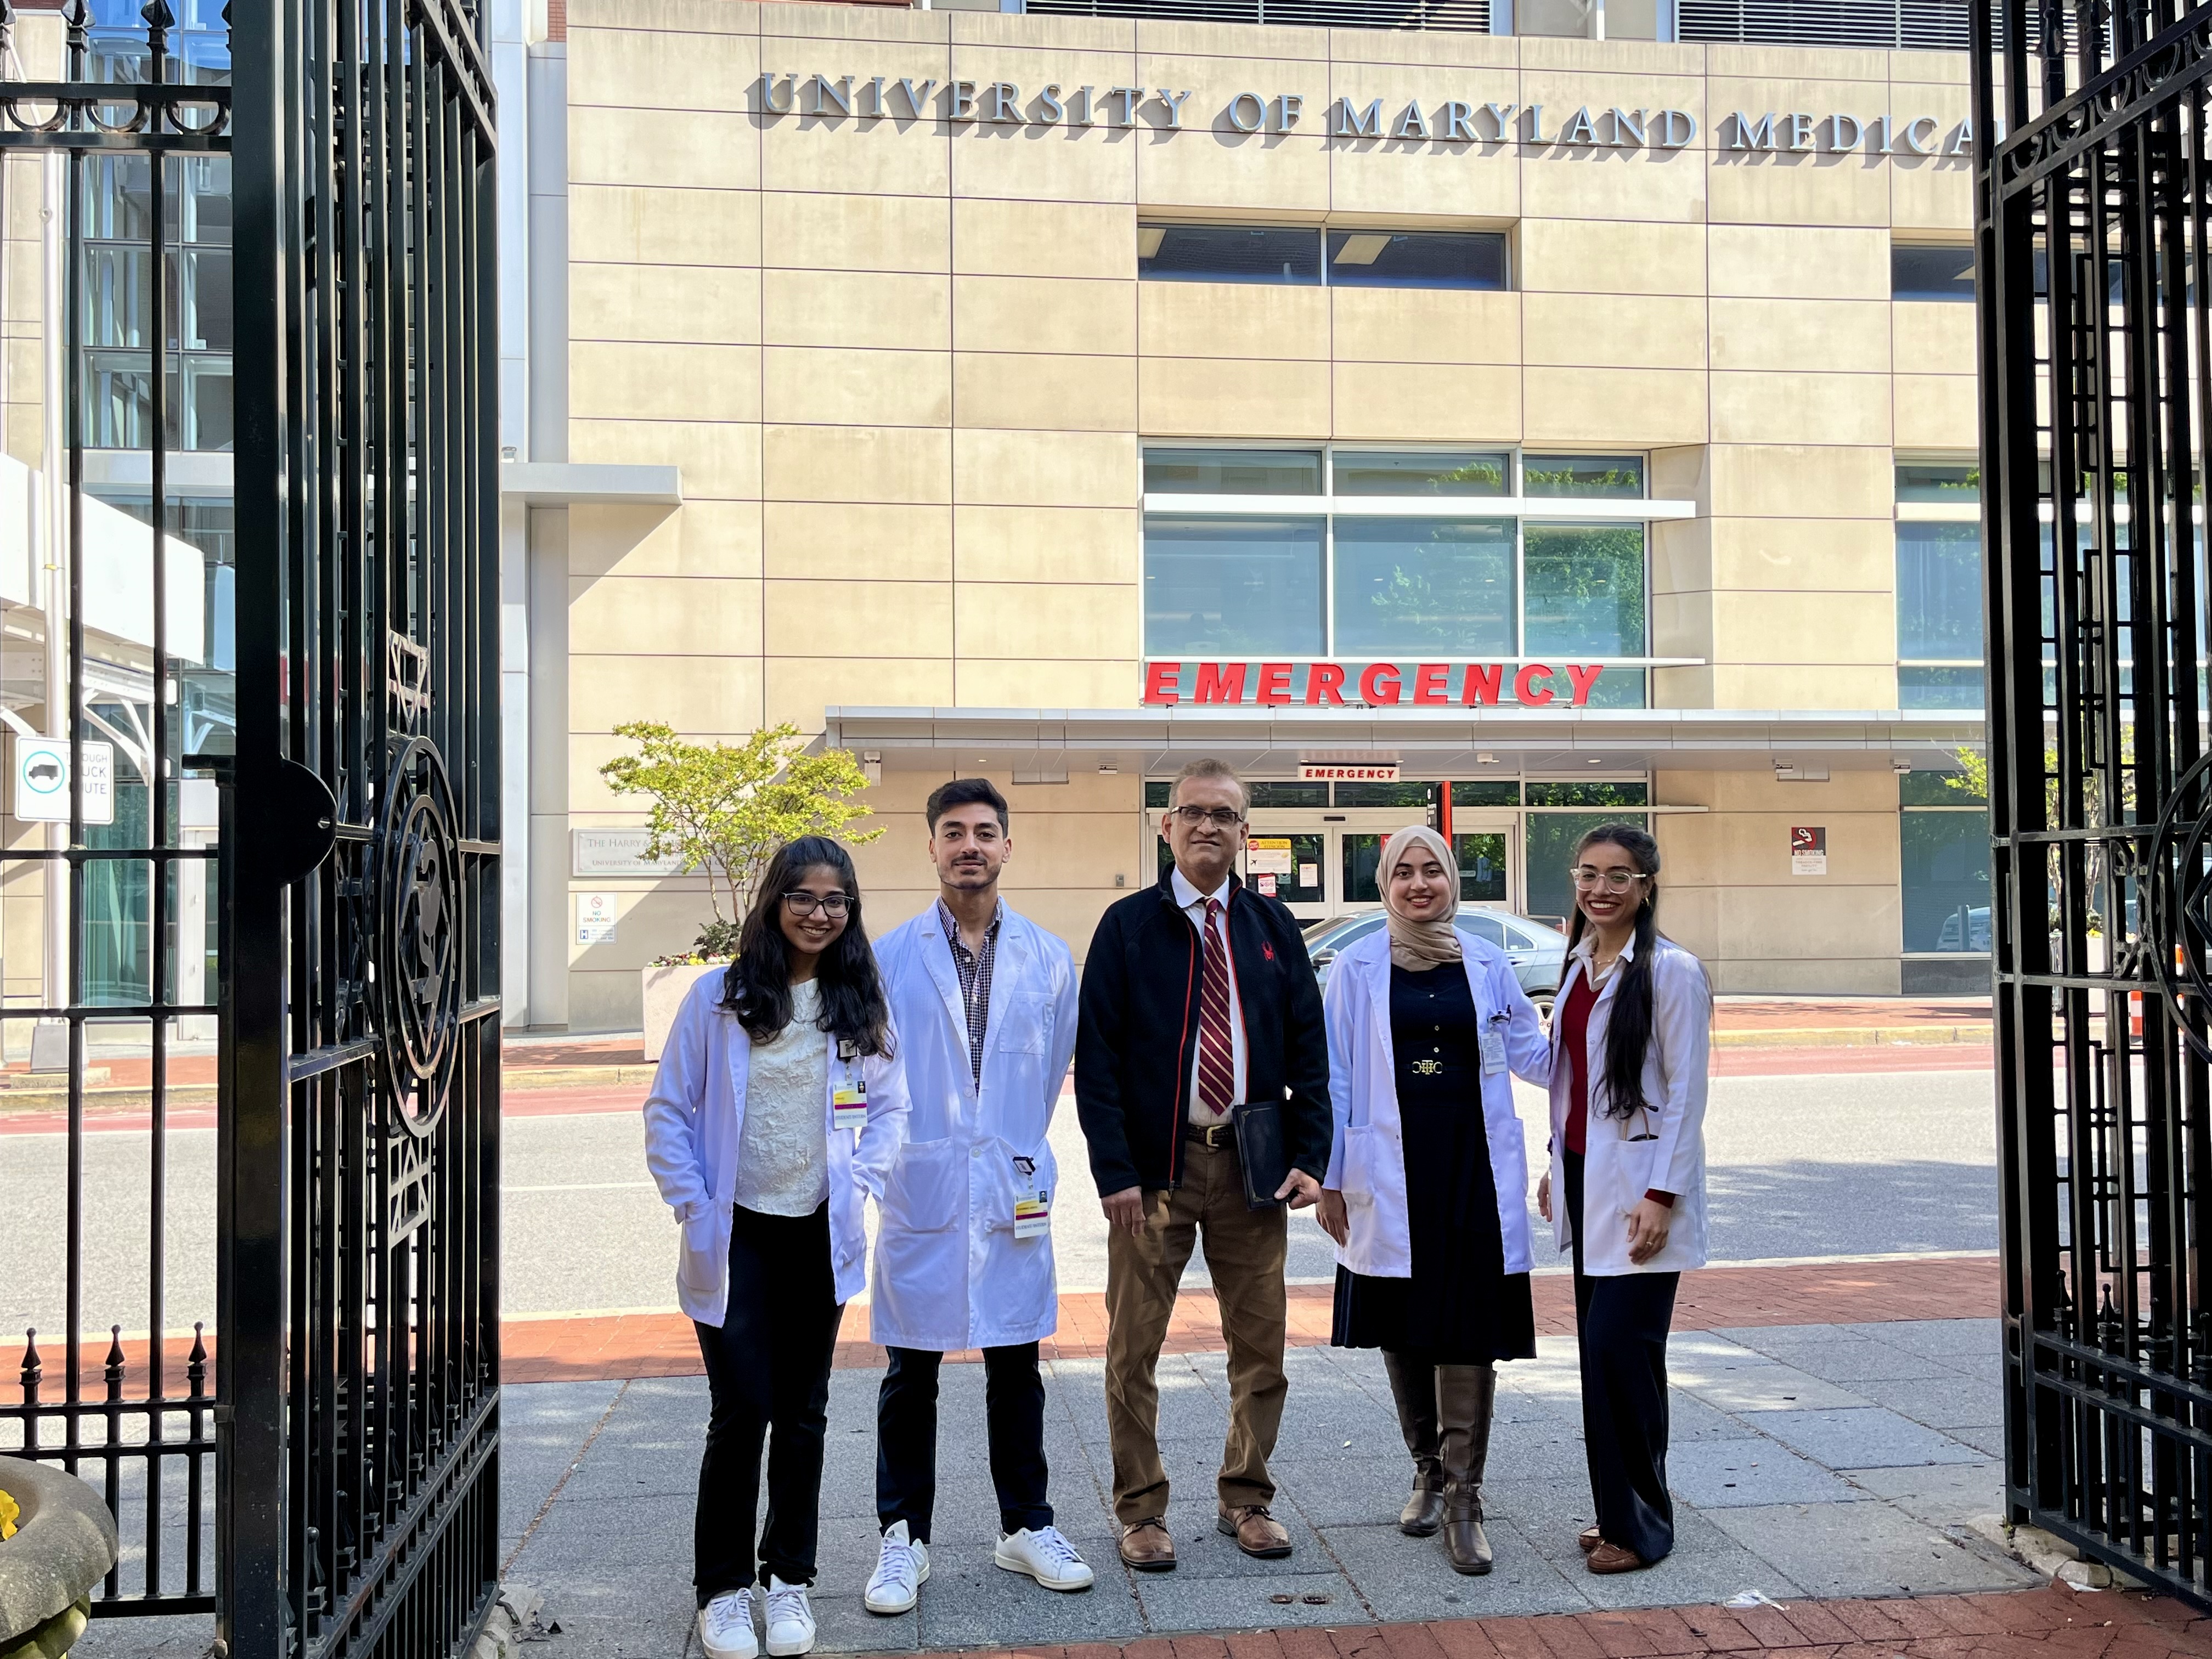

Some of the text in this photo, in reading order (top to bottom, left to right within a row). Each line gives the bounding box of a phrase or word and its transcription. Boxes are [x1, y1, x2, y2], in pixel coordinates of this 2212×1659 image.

[760, 72, 1192, 129] UNIVERSITY
[1229, 92, 1304, 133] OF
[1337, 97, 1697, 150] MARYLAND
[1143, 662, 1604, 706] EMERGENCY
[65, 752, 108, 763] TOUGH
[1305, 769, 1395, 778] EMERGENCY
[588, 838, 606, 847] THE
[609, 838, 641, 847] HARRY
